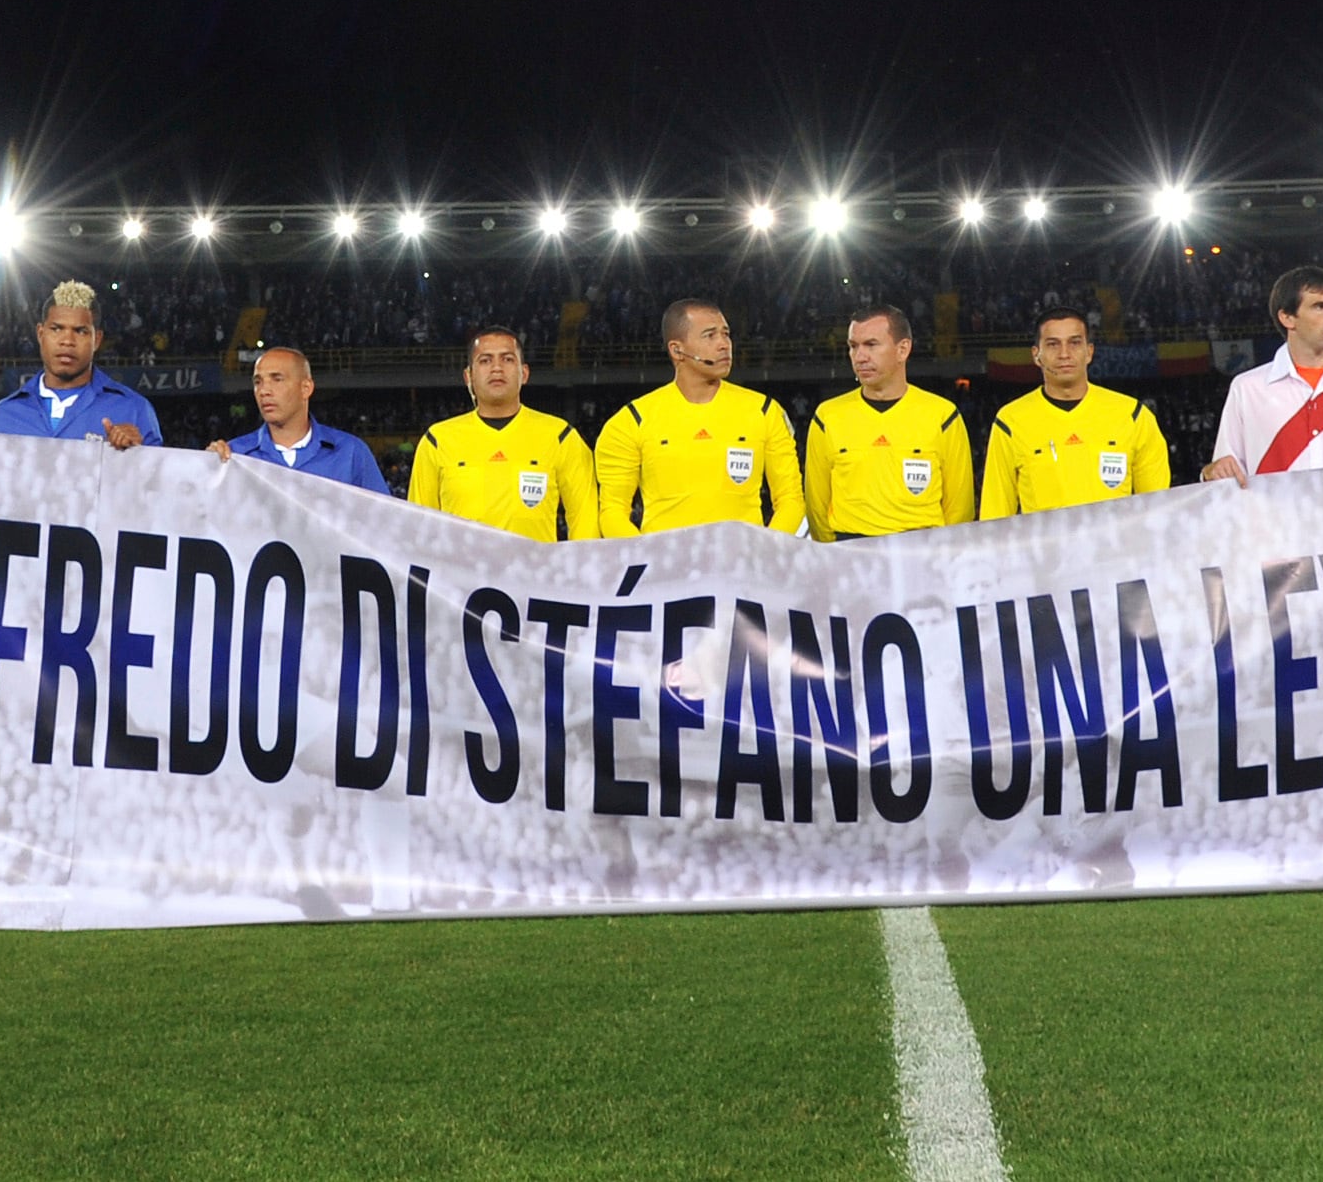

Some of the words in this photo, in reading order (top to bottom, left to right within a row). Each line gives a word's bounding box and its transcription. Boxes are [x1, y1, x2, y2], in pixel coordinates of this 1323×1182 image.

[137, 369, 202, 390] AZUL
[730, 461, 750, 470] FIFA
[1102, 466, 1122, 474] FIFA
[907, 473, 927, 482] FIFA
[522, 485, 542, 495] FIFA
[335, 555, 430, 796] DI
[463, 564, 932, 823] STÉFANO
[957, 579, 1183, 820] UNA
